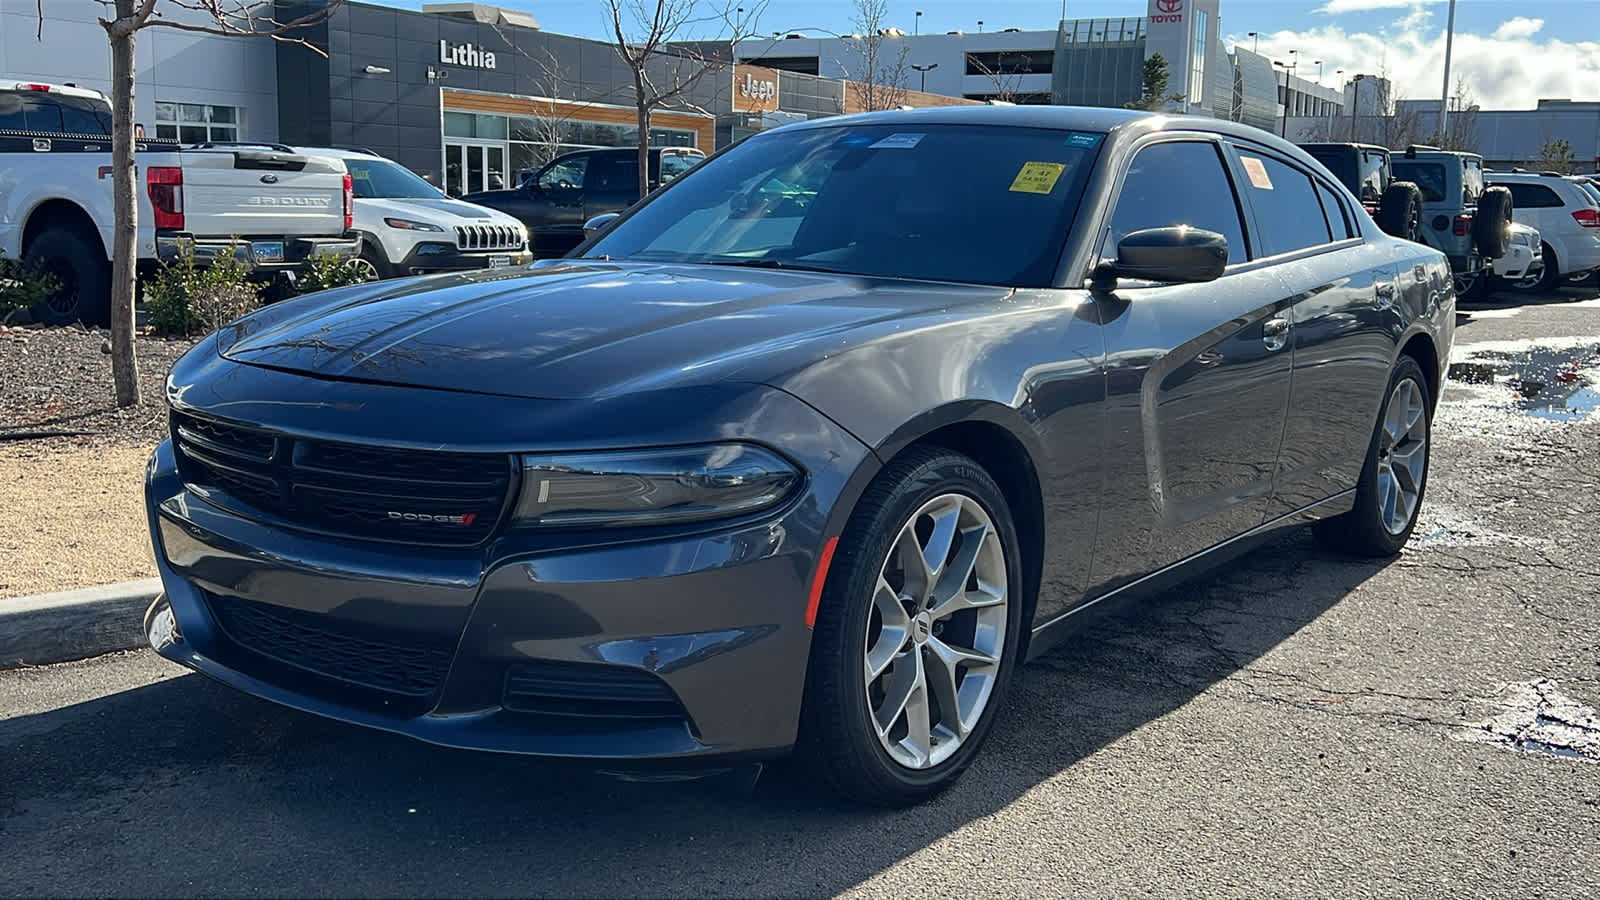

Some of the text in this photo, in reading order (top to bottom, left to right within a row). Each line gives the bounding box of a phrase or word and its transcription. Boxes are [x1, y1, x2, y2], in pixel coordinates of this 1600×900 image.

[440, 39, 496, 69] Lithia
[741, 73, 775, 104] Jeep
[388, 511, 464, 523] DODGE
